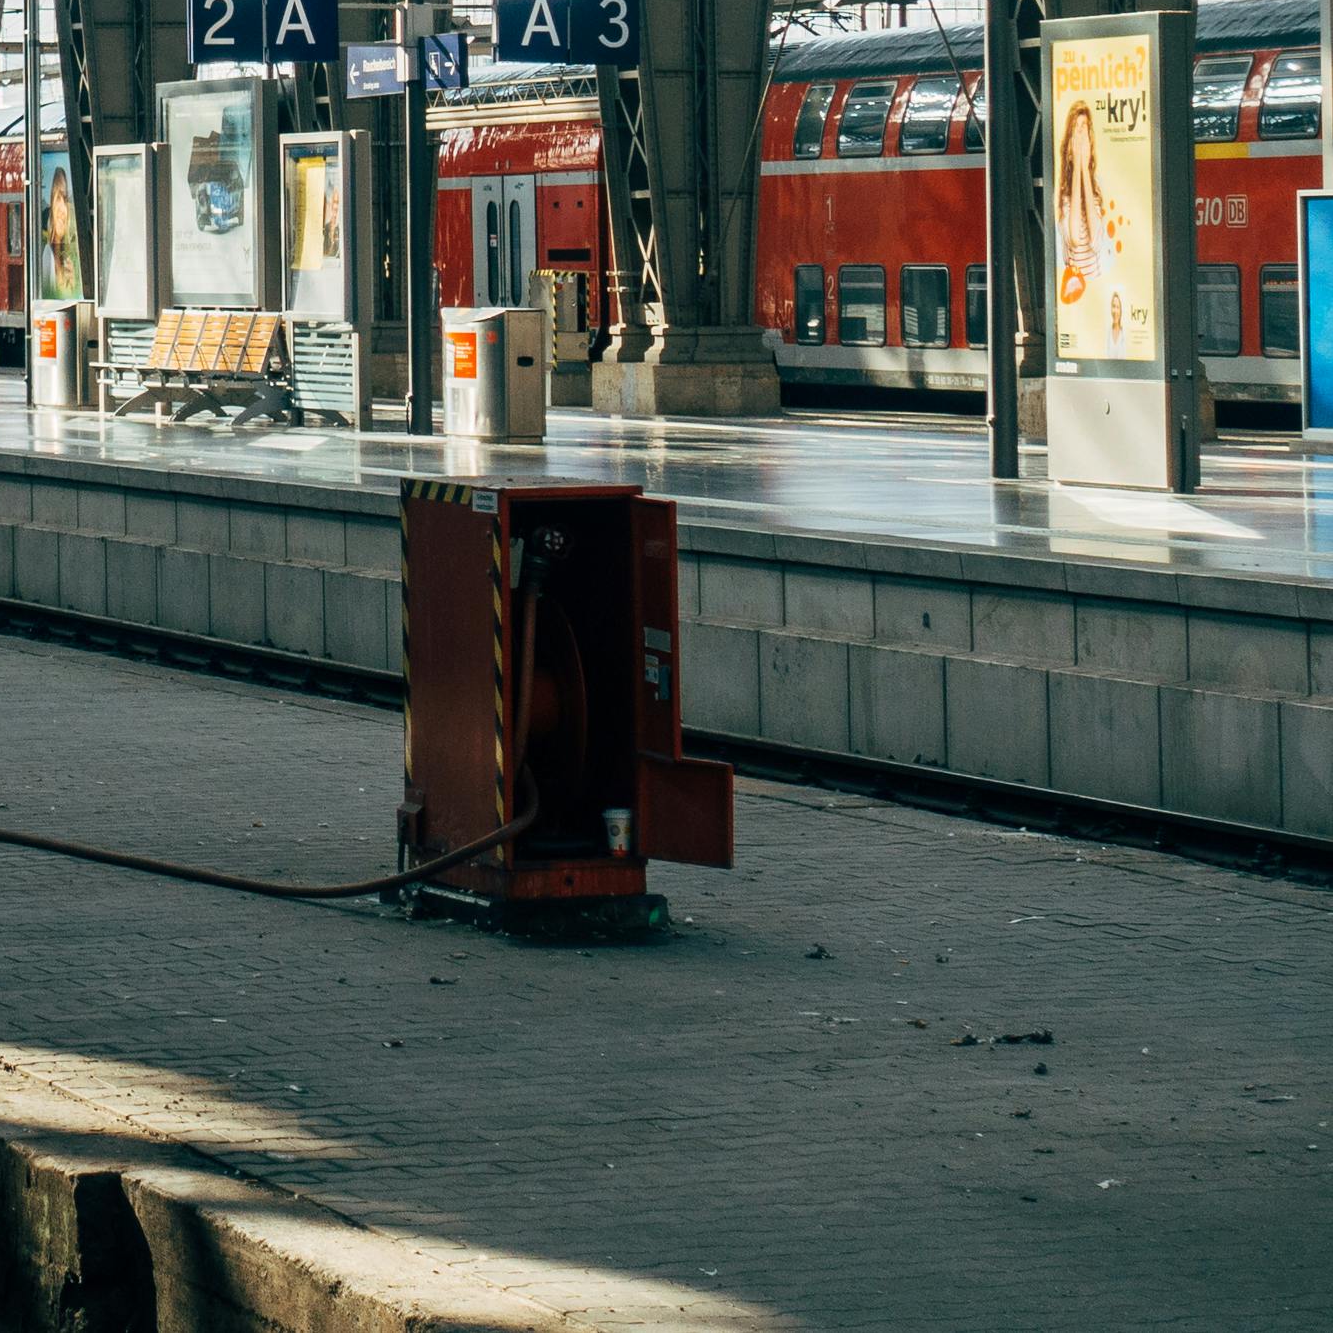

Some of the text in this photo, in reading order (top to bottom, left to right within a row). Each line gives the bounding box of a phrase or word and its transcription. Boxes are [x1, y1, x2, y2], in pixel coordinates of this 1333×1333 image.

[1063, 50, 1075, 64] zu
[1056, 45, 1146, 102] peinlich?
[1095, 90, 1147, 132] zu kry!
[826, 197, 834, 221] 1
[1228, 198, 1246, 225] DB
[827, 275, 835, 300] 2
[1130, 304, 1149, 325] kry
